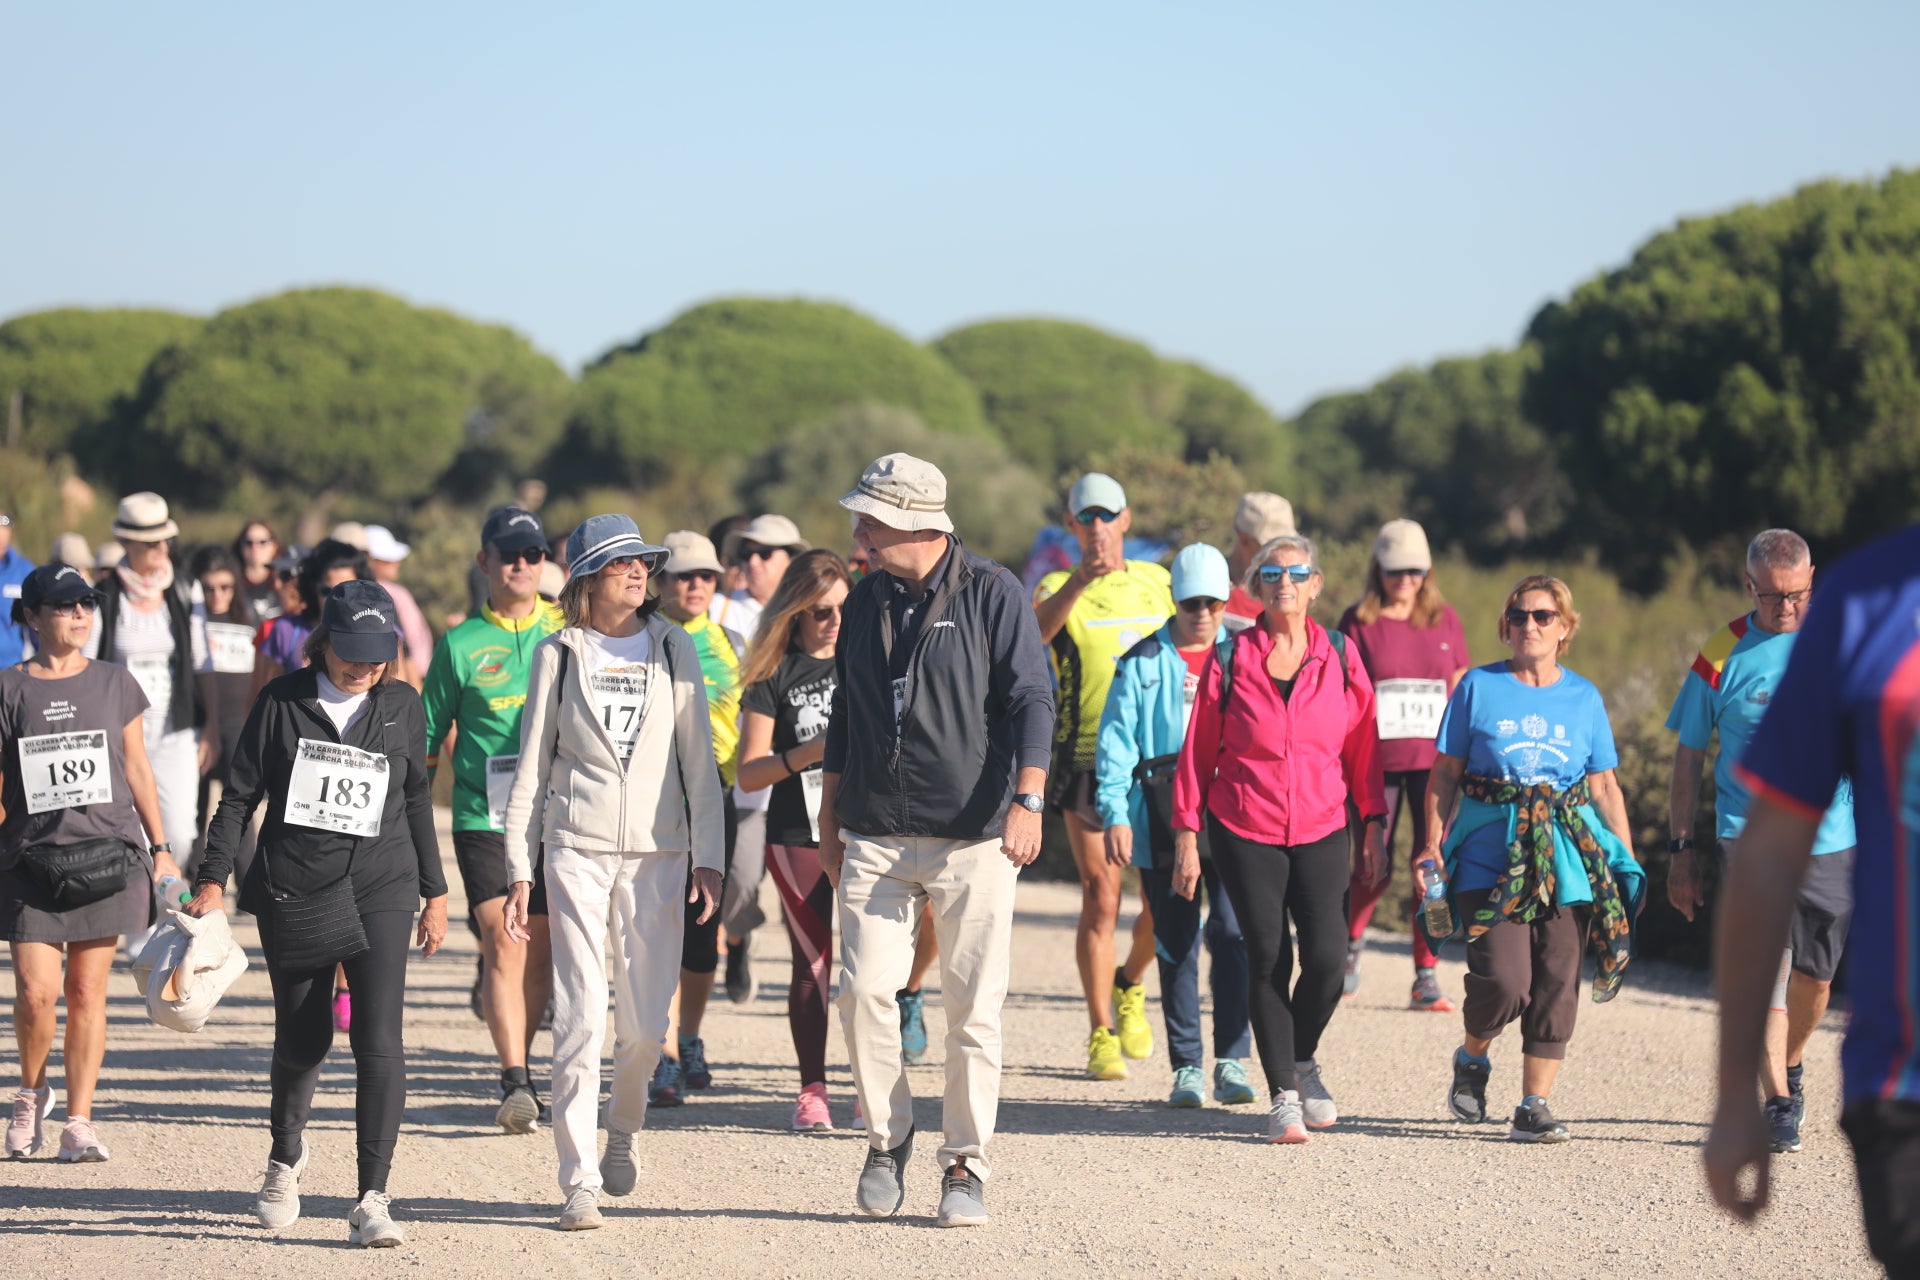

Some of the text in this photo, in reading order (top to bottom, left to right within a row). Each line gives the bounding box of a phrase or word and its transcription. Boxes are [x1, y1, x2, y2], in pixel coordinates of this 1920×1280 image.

[592, 684, 621, 692] ARCHA
[601, 704, 642, 733] 17
[1400, 702, 1434, 719] 191
[309, 753, 342, 764] MARCHA
[316, 746, 352, 757] CARRERA
[47, 758, 96, 787] 189
[316, 775, 371, 809] 183
